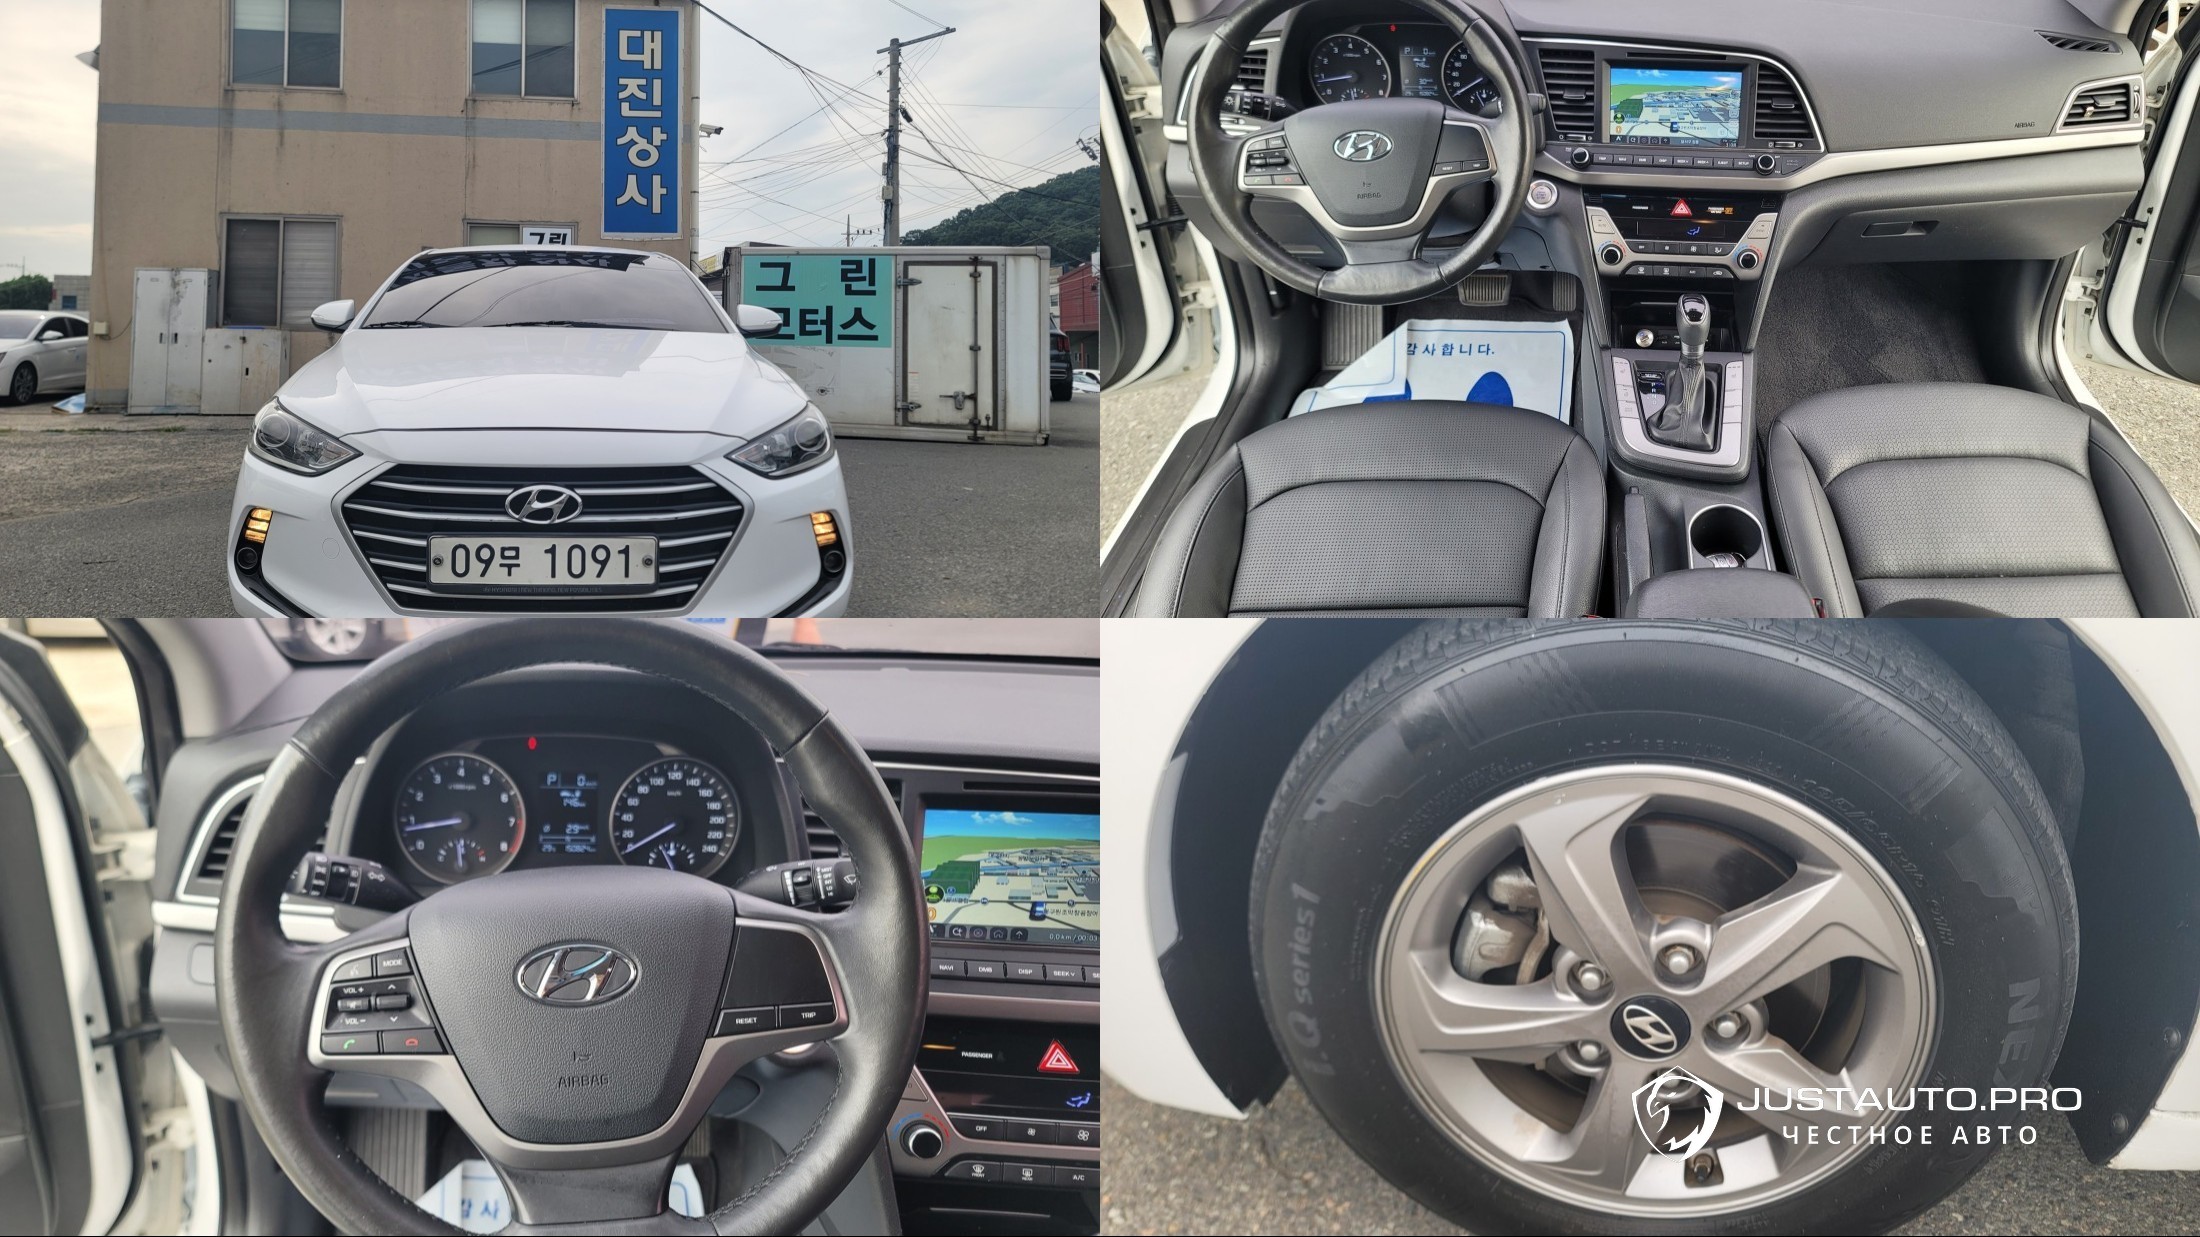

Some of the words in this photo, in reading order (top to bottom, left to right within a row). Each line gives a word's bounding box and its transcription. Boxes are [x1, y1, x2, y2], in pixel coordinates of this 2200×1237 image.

[615, 28, 668, 215] 대진상사
[450, 543, 521, 578] 09무
[543, 543, 631, 579] 1091
[457, 767, 465, 777] 4
[667, 771, 683, 780] 120
[433, 773, 442, 784] 3
[482, 775, 490, 785] 5
[546, 773, 557, 786] P
[649, 777, 665, 786] 100
[686, 778, 701, 786] 140
[637, 785, 650, 794] 80
[698, 789, 714, 797] 160
[627, 798, 639, 806] 60
[706, 802, 722, 810] 180
[409, 816, 415, 825] 1
[508, 817, 515, 827] 7
[621, 813, 634, 822] 40
[709, 816, 726, 824] 200
[622, 830, 634, 838] 20
[707, 831, 723, 839] 220
[702, 844, 718, 853] 240
[382, 959, 402, 967] MODE
[961, 1051, 993, 1059] PASSENGER
[558, 1074, 609, 1088] AIRBAG
